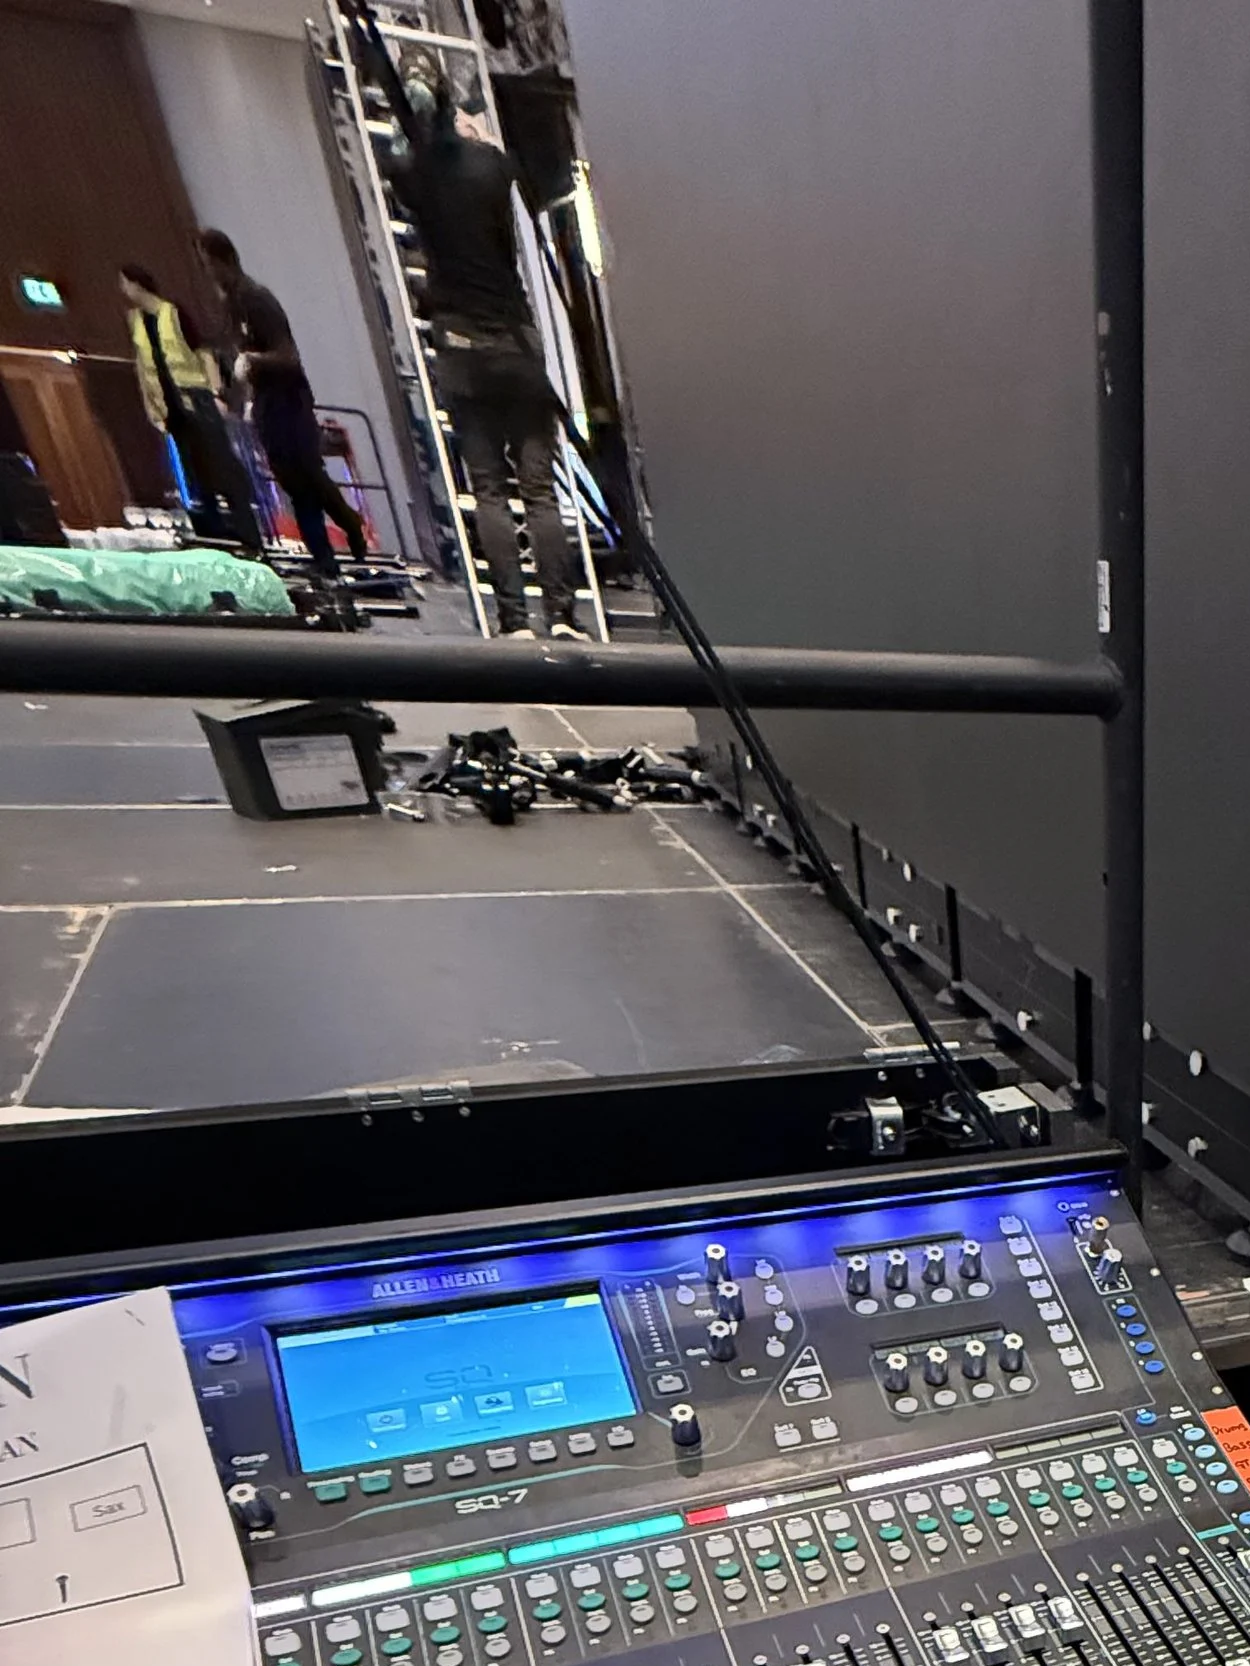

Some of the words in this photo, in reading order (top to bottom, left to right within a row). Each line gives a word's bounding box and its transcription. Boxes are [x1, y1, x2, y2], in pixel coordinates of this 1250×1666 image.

[372, 1269, 500, 1299] ALLEN&HEATH
[423, 1364, 494, 1388] SQ
[1211, 1422, 1249, 1436] Drums
[92, 1501, 126, 1518] Sax
[455, 1489, 528, 1515] SQ-7
